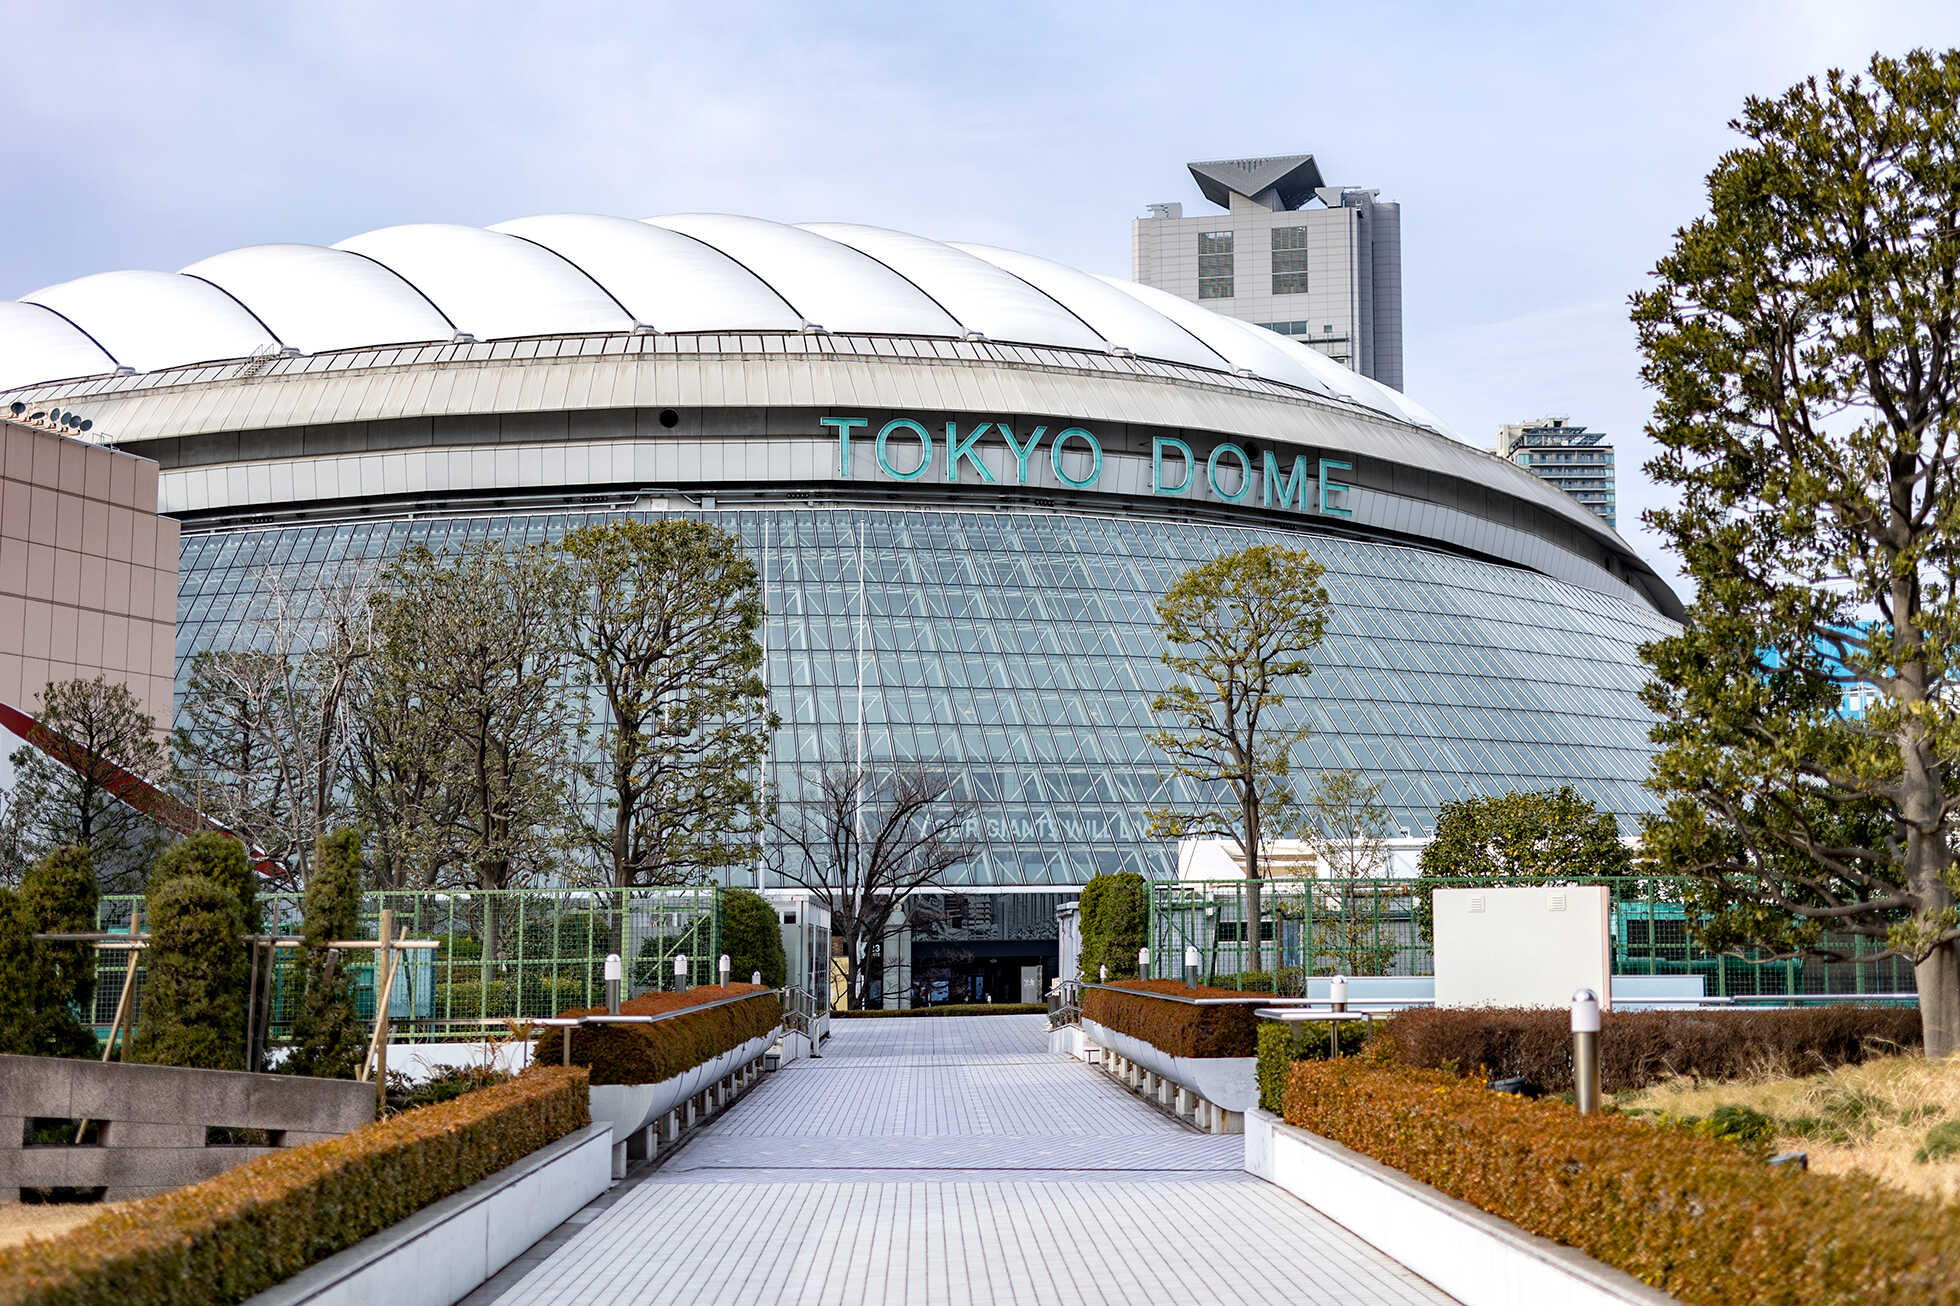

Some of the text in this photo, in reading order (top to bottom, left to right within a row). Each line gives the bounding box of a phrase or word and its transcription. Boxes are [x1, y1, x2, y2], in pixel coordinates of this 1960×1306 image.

[820, 416, 1353, 517] TOKYO DOME
[1065, 819, 1112, 840] WILL
